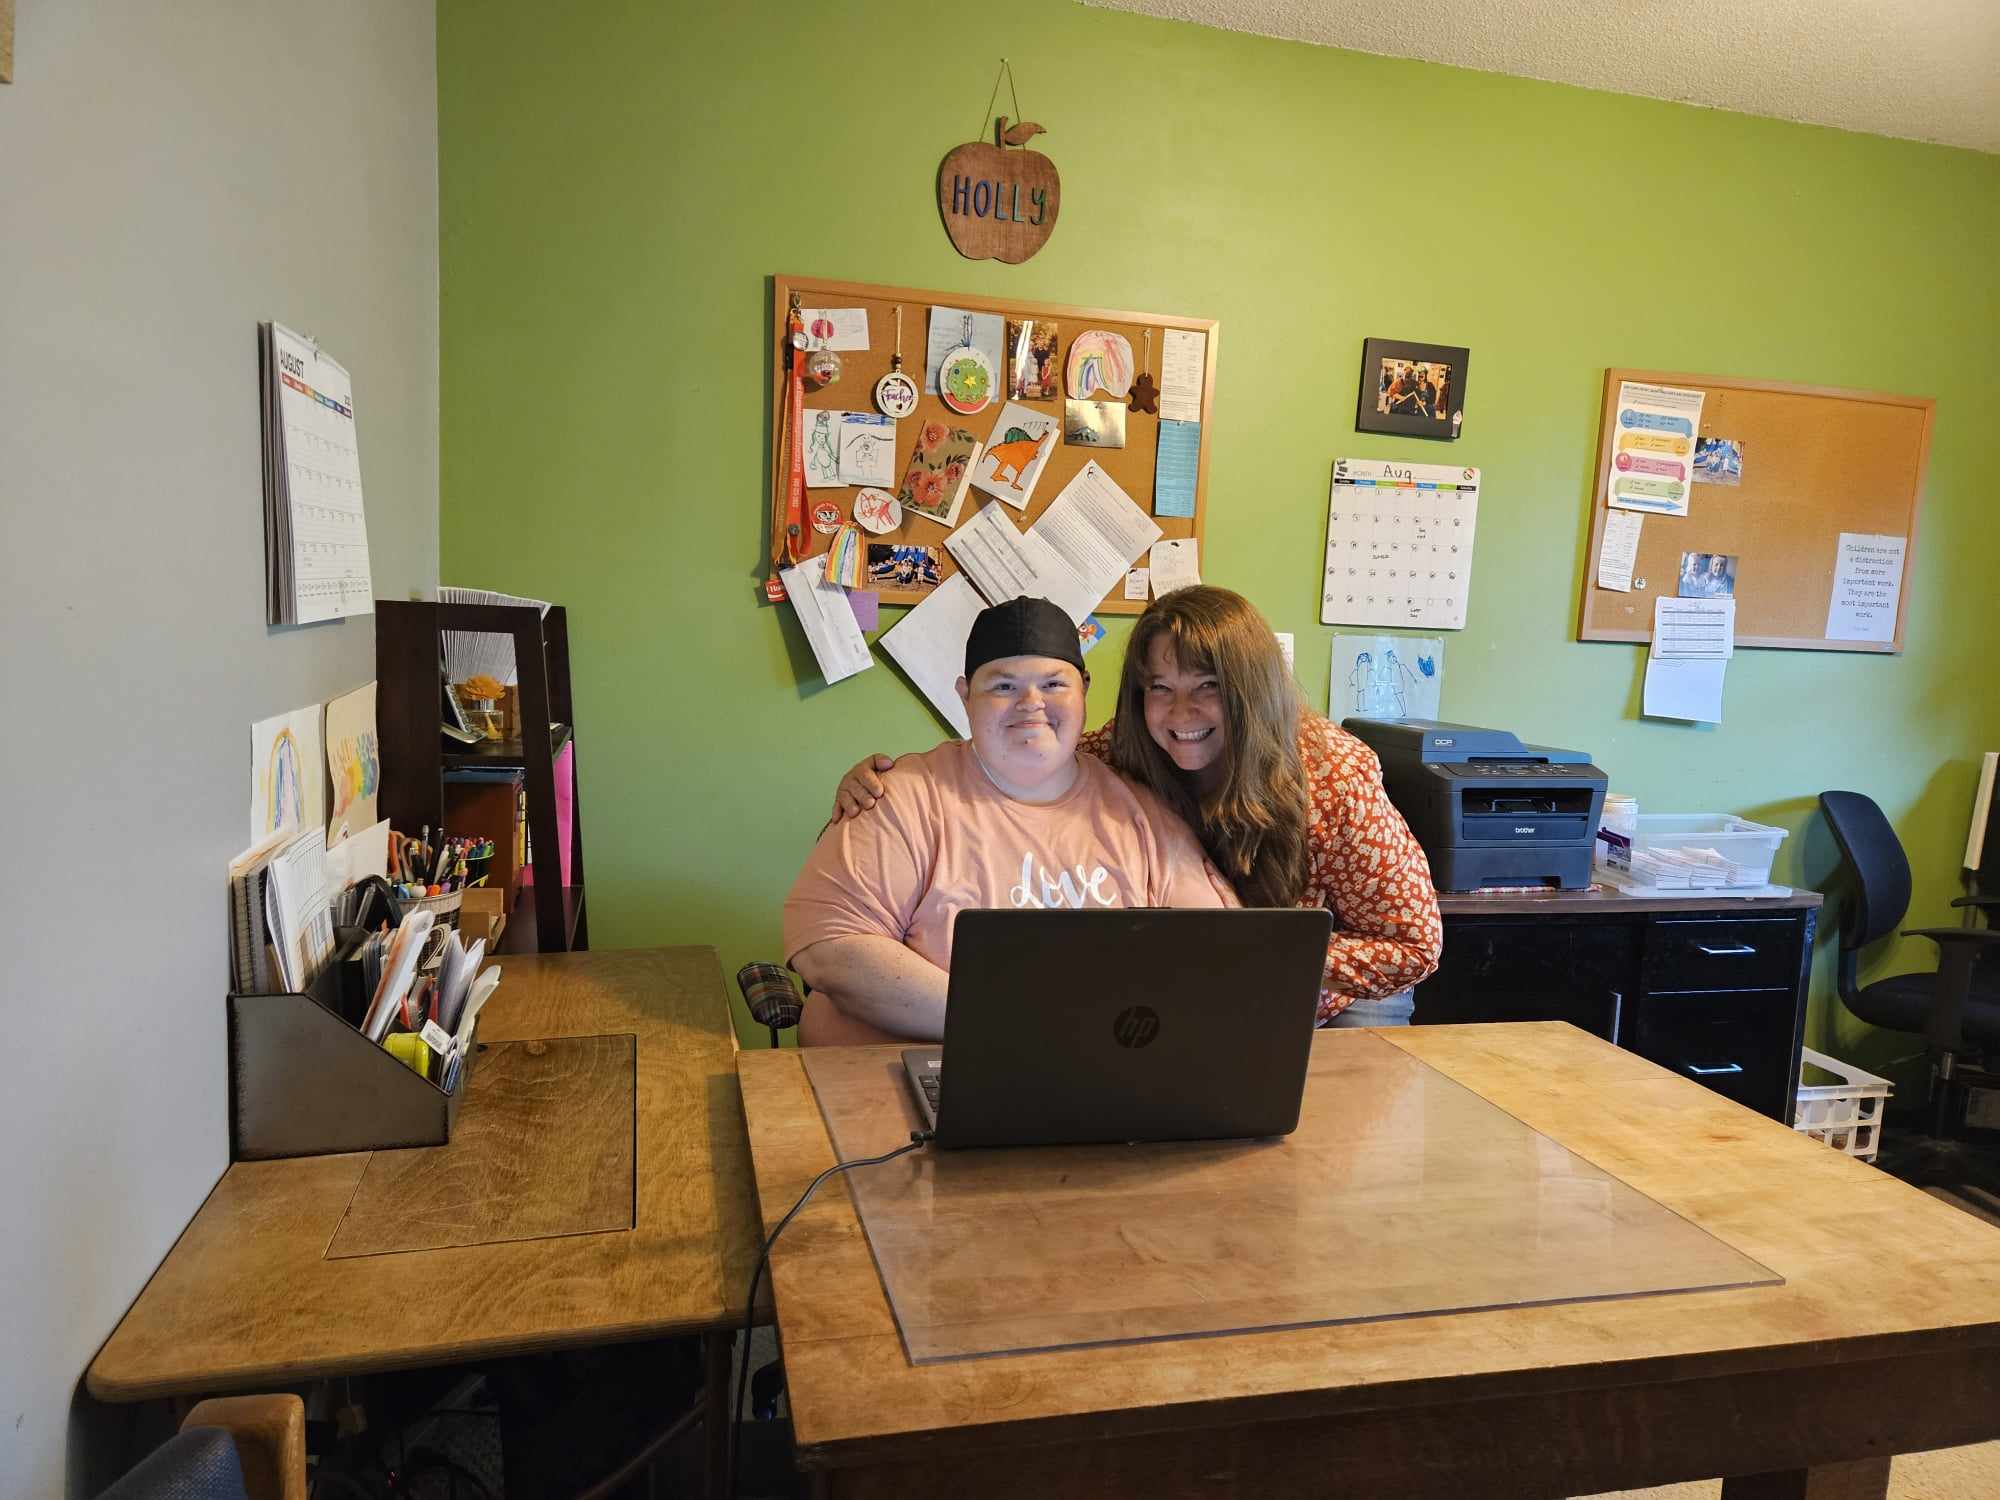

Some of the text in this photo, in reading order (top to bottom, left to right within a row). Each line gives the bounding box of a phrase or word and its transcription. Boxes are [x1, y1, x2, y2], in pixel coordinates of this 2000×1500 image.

[952, 175, 1047, 225] HOLLY
[280, 348, 304, 379] AUGUST
[1116, 1006, 1159, 1048] hp
